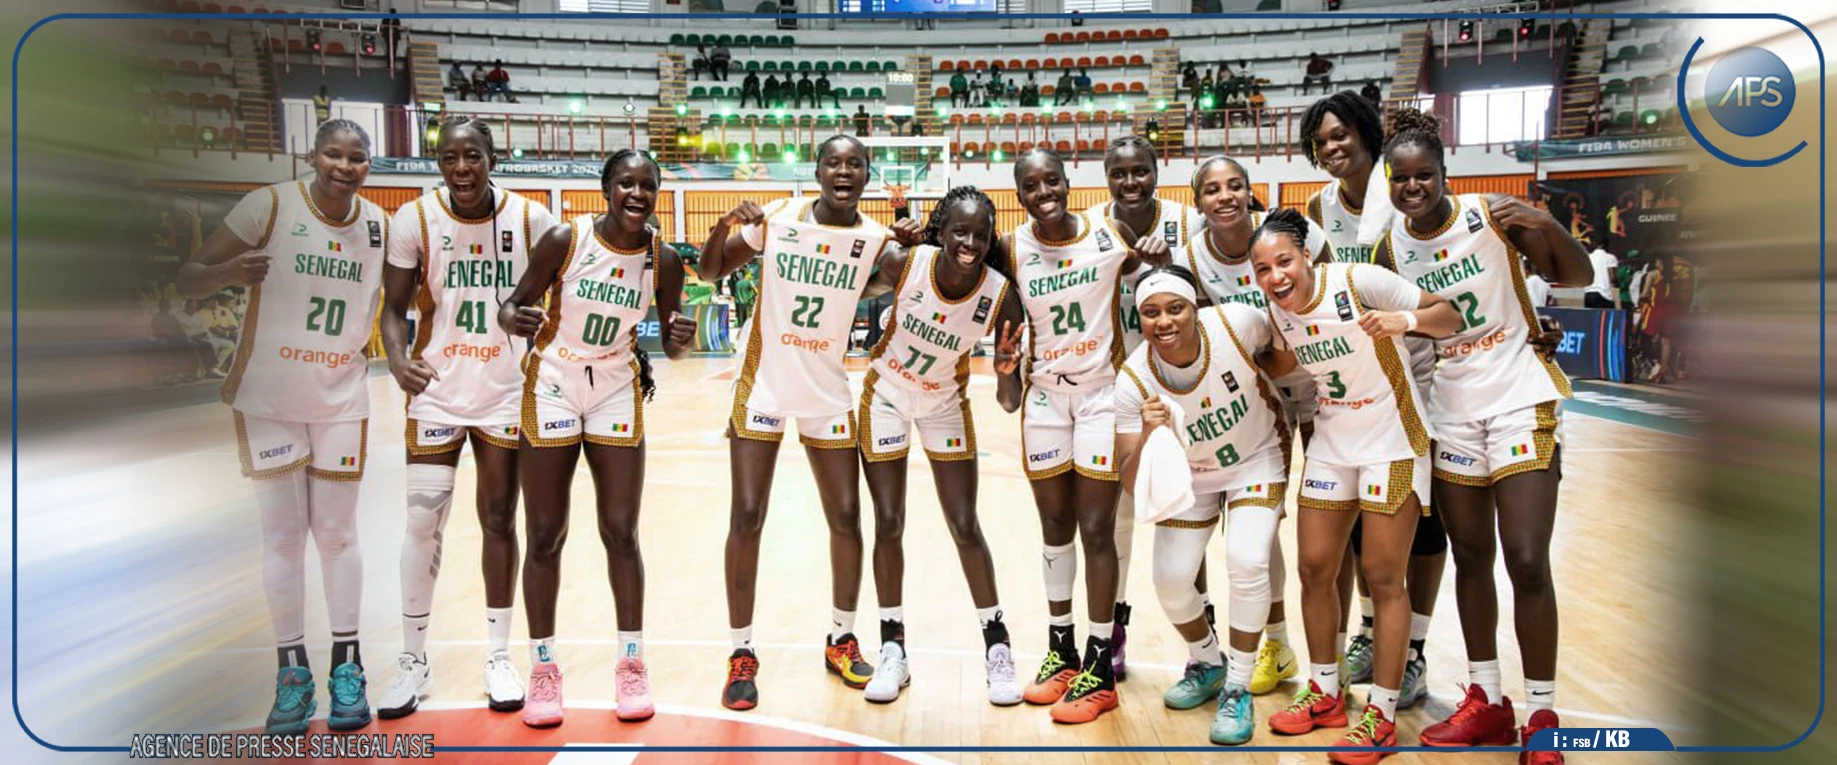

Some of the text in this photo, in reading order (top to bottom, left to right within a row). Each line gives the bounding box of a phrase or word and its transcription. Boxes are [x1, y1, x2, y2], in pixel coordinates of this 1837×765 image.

[1578, 136, 1687, 153] FIBA WOMEN'S
[294, 253, 363, 283] SENEGAL
[443, 260, 516, 288] ENEGAL
[776, 252, 858, 290] SENEGAL
[1029, 266, 1100, 297] SENEGAL
[1415, 253, 1485, 294] SENEGAL
[577, 279, 642, 310] SENEGAL
[306, 296, 347, 336] 20
[456, 300, 487, 334] 41
[791, 295, 825, 328] 22
[1050, 301, 1086, 336] 24
[582, 313, 621, 346] 00
[902, 312, 962, 352] SENEGAL
[278, 345, 351, 369] orange
[443, 343, 502, 364] orange
[903, 345, 938, 376] 77
[887, 359, 941, 391] orage
[1325, 369, 1347, 399] 3
[424, 427, 456, 438] 1XBET
[544, 419, 576, 431] 1XBET
[1186, 393, 1249, 447] ENEGAL
[259, 444, 294, 460] 1XBET
[878, 434, 907, 447] 1XBET
[1029, 448, 1061, 462] 1XBET
[1215, 443, 1240, 468] 8
[1440, 451, 1478, 467] 1XBET
[1304, 479, 1338, 491] 1XBET
